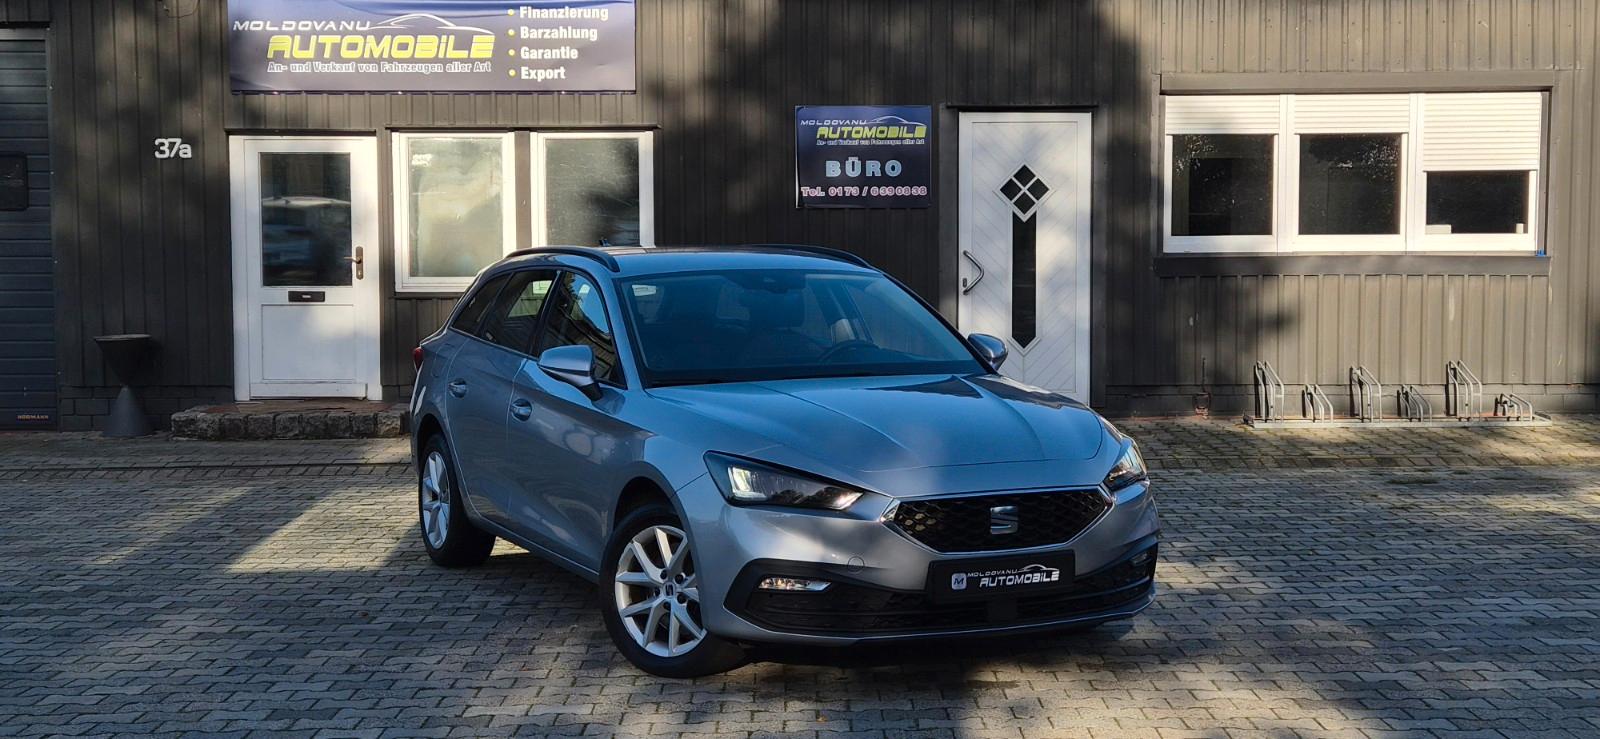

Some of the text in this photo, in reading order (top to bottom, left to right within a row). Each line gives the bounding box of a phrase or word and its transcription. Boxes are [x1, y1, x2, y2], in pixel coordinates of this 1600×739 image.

[519, 6, 609, 21] Finanzierung
[233, 20, 370, 31] MOLDOVANU
[520, 26, 598, 41] Barzahlung
[520, 46, 579, 60] Garantie
[267, 61, 492, 75] An- und Verkauf von Fahrzeugen aller Art
[520, 66, 566, 82] Export
[154, 137, 192, 159] 37a
[825, 156, 902, 178] BÜRO
